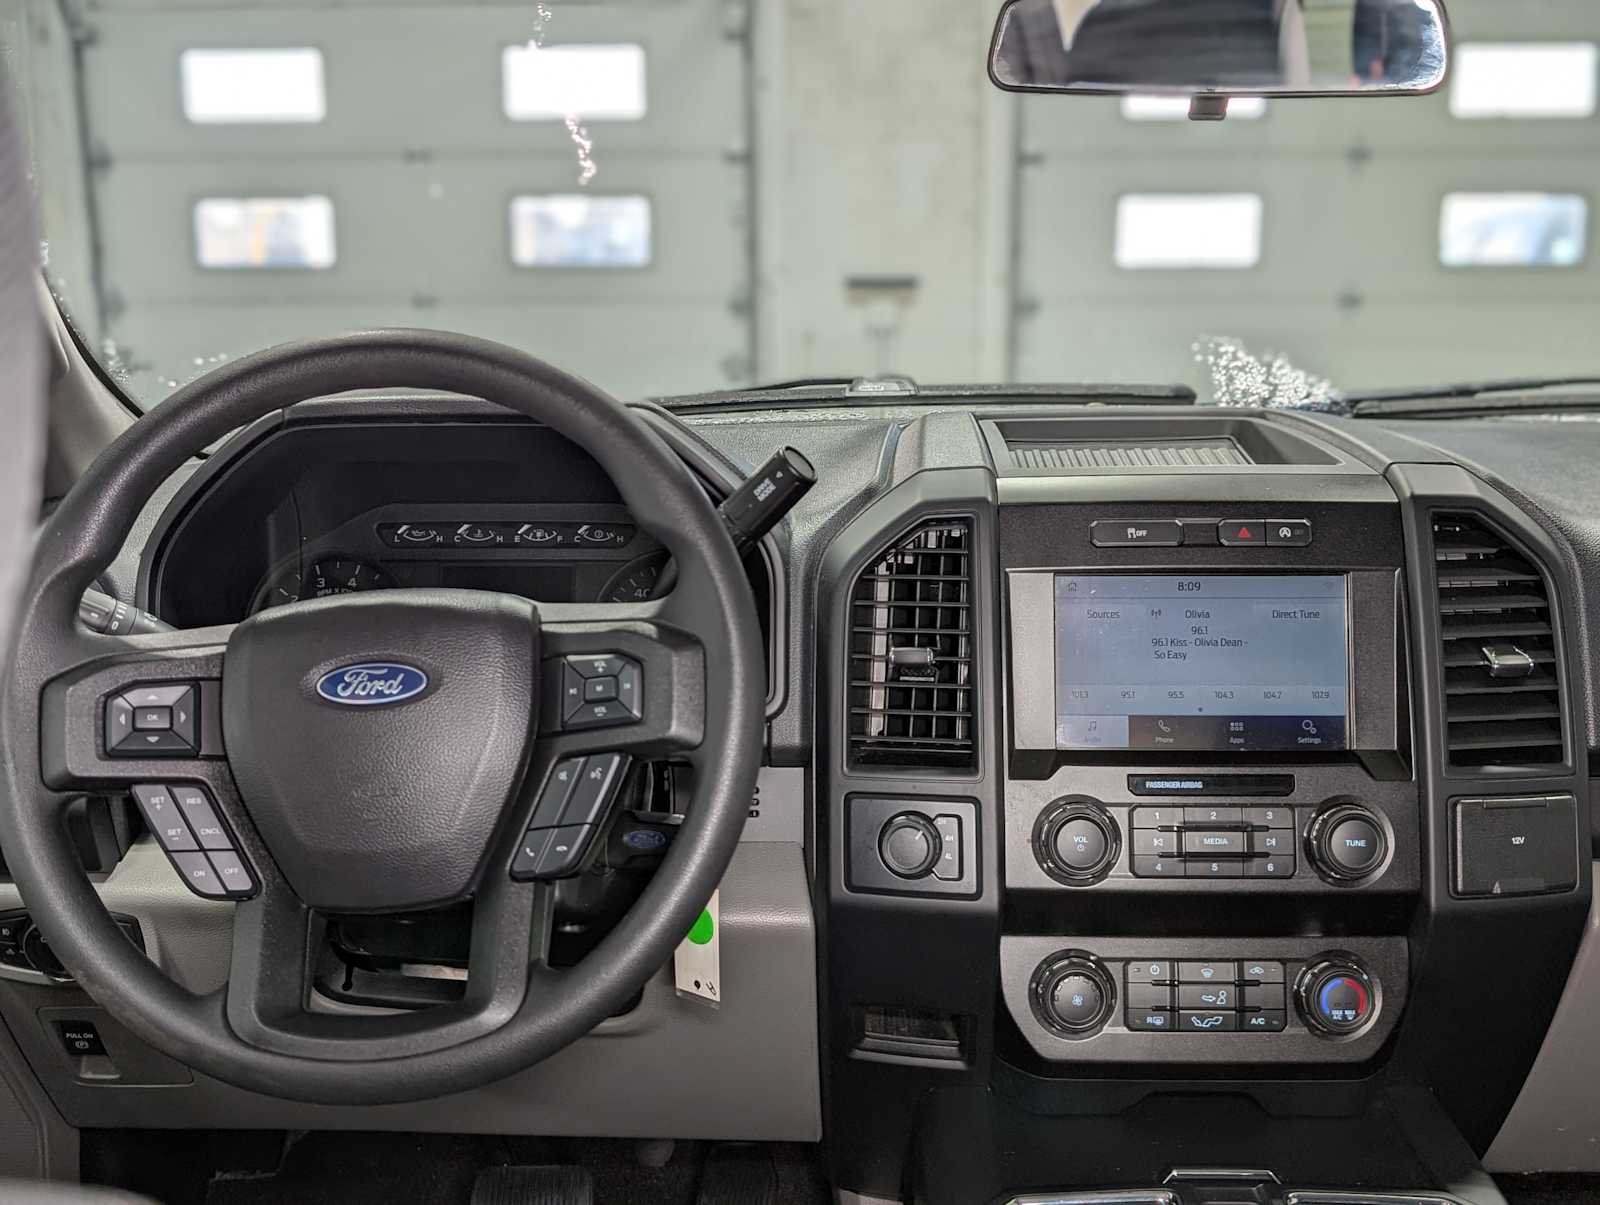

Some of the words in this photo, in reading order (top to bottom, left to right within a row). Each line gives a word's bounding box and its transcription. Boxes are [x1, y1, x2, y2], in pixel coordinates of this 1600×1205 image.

[394, 535, 401, 543] L
[436, 535, 444, 543] H
[454, 535, 461, 543] C
[496, 535, 504, 543] H
[514, 535, 521, 543] E
[557, 535, 563, 543] F
[574, 535, 581, 543] C
[616, 535, 624, 543] H
[316, 577, 326, 588] 3
[347, 577, 357, 588] 4
[1177, 581, 1201, 592] 8:09
[1087, 608, 1120, 619] Sources
[1185, 608, 1211, 619] Olivia
[1272, 609, 1298, 619] Direct
[1299, 609, 1320, 619] Tune
[1191, 625, 1208, 635] 96.1
[1151, 637, 1169, 647] 96.1
[1170, 637, 1188, 647] Kiss
[1194, 637, 1219, 647] Olivia
[1220, 637, 1243, 647] Dean
[1154, 650, 1166, 660] So
[1167, 650, 1187, 661] Easy
[337, 667, 405, 697] Ford
[147, 713, 158, 721] OK
[1155, 736, 1174, 744] Phone
[1229, 736, 1245, 744] Apps
[1297, 736, 1322, 744] Settings
[1145, 780, 1180, 789] PASSENGER
[151, 796, 165, 804] SET
[1155, 811, 1160, 820] 1
[1210, 811, 1217, 820] 2
[1266, 811, 1273, 820] 3
[167, 828, 182, 836] SET
[1073, 835, 1088, 844] VOL
[1203, 837, 1229, 846] MEDIA
[1345, 839, 1366, 848] TUNE
[1511, 836, 1525, 845] 12V
[224, 866, 239, 875] OFF
[1155, 863, 1162, 872] 4
[1211, 863, 1218, 872] 5
[1267, 863, 1274, 872] 6
[193, 869, 205, 878] ON
[1251, 1017, 1265, 1025] A/C
